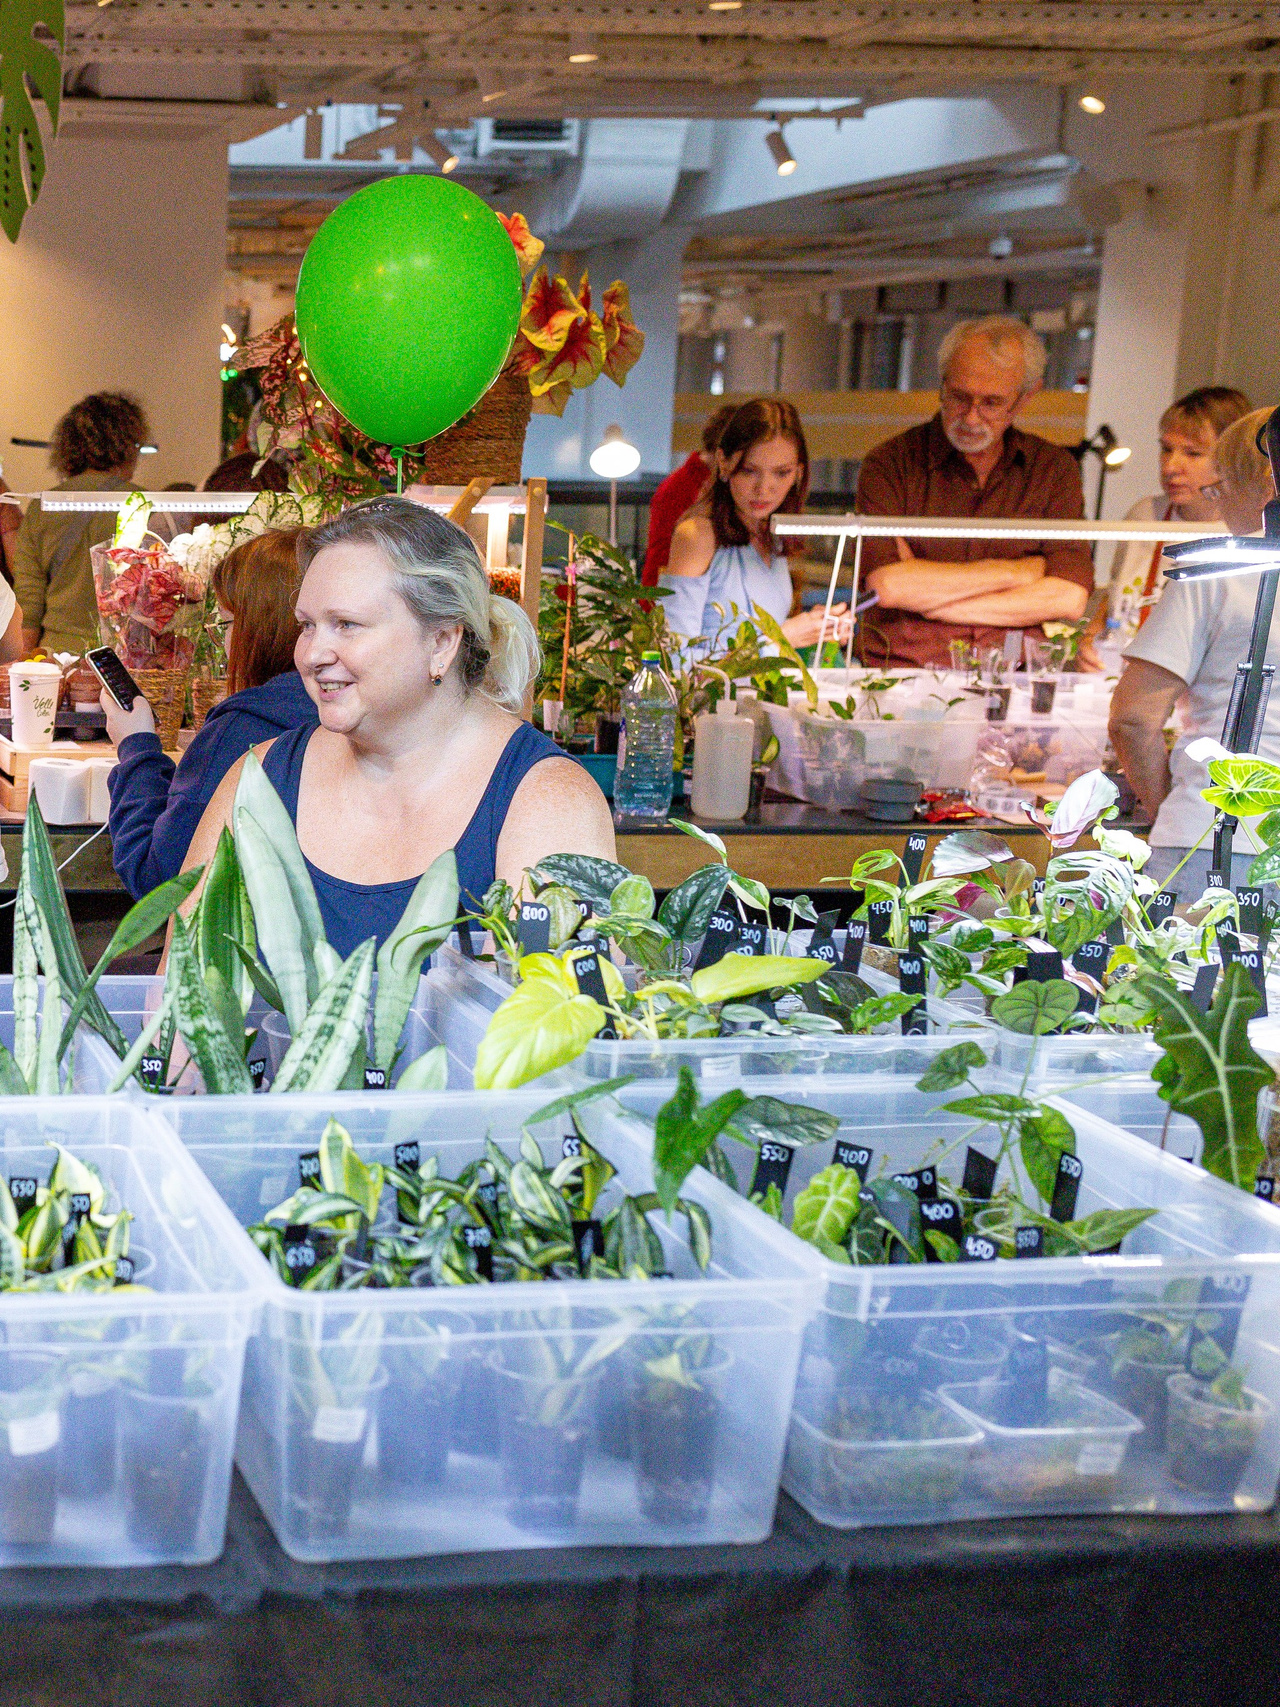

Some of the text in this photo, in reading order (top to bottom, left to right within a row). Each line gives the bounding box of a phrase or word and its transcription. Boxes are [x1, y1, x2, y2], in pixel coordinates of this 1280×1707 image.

[909, 837, 926, 851] 400
[871, 899, 894, 915] 450
[1237, 892, 1260, 907] 350
[522, 905, 548, 922] 800
[709, 916, 733, 932] 300
[848, 921, 864, 939] 400
[909, 919, 927, 933] 400
[741, 927, 762, 944] 300
[811, 945, 834, 961] 350
[1079, 944, 1103, 958] 350
[899, 958, 921, 975] 400
[142, 1058, 163, 1073] 350
[365, 1071, 385, 1086] 400
[761, 1144, 789, 1163] 550
[838, 1147, 870, 1166] 400
[921, 1203, 955, 1221] 400
[965, 1235, 995, 1260] 450
